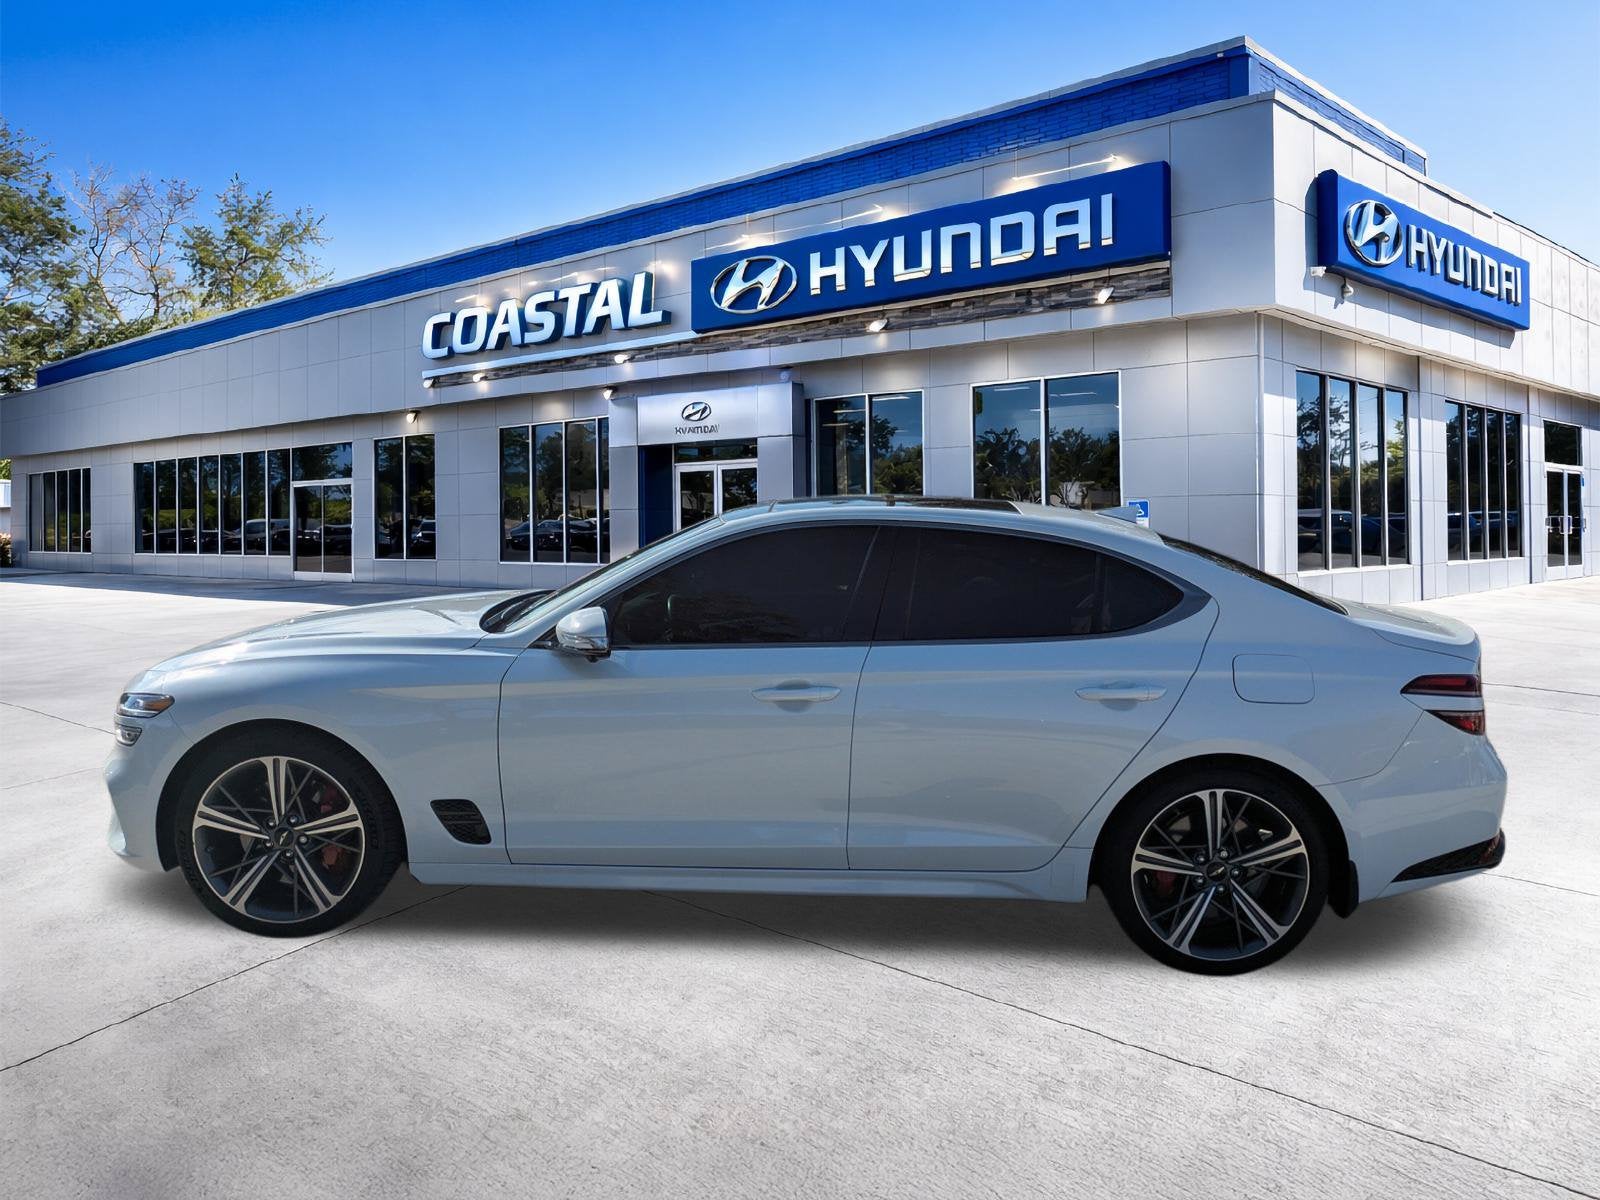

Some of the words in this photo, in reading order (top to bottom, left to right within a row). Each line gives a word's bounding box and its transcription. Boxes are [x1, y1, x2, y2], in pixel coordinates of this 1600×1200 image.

[809, 193, 1113, 295] HYUNDAI
[1406, 224, 1522, 306] HYUNDAI
[422, 271, 671, 359] COASTAL
